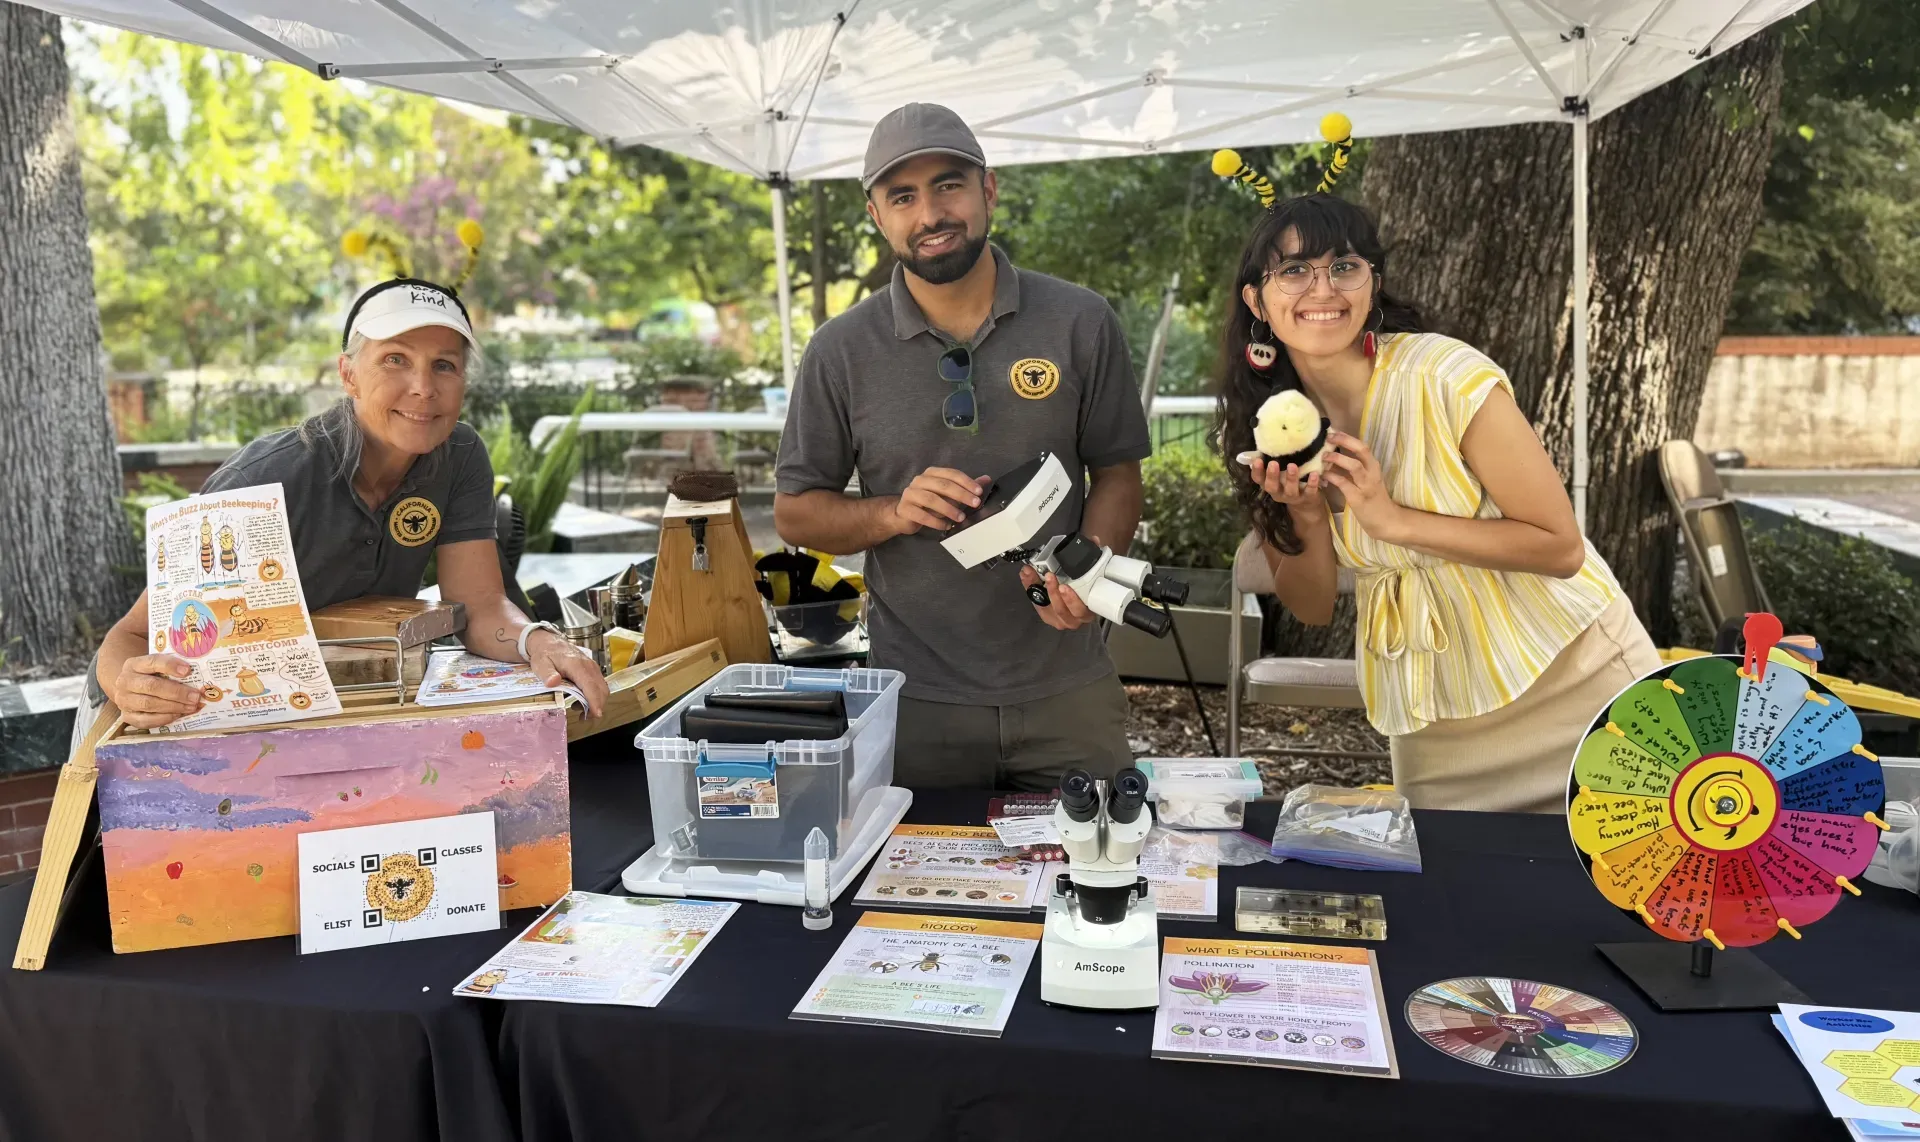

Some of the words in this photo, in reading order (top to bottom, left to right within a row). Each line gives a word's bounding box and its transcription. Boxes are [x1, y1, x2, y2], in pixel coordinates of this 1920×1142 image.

[1017, 360, 1050, 370] CALIFORNIA
[1038, 484, 1059, 513] AmScope
[150, 514, 169, 532] What's
[168, 512, 178, 520] the
[200, 500, 220, 511] About
[222, 498, 278, 511] Beekeeping?
[397, 502, 432, 516] CALIFORNIA
[174, 589, 204, 602] NECTAR
[228, 638, 298, 655] HONEYCOMB
[231, 694, 284, 708] HONEY!
[1758, 697, 1768, 716] and
[1634, 697, 1660, 723] eat?
[1741, 709, 1748, 717] is
[1631, 722, 1643, 735] do
[1793, 728, 1803, 737] is
[1804, 711, 1821, 724] the
[1794, 743, 1804, 754] of
[1817, 706, 1848, 733] worker
[1664, 728, 1691, 756] bees
[1738, 723, 1748, 750] What
[1645, 737, 1679, 764] What
[1621, 779, 1635, 790] do
[1642, 777, 1666, 793] Why
[1647, 770, 1670, 785] have
[1578, 803, 1608, 816] have?
[1613, 800, 1637, 809] bee
[1611, 811, 1638, 822] does
[1637, 815, 1659, 830] How
[1790, 813, 1816, 822] How
[1599, 826, 1633, 839] many
[1780, 823, 1810, 836] eyes
[1814, 828, 1841, 840] does
[441, 845, 482, 857] CLASSES
[1663, 845, 1683, 862] Can
[1821, 840, 1857, 860] have?
[312, 861, 356, 873] SOCIALS
[1650, 861, 1662, 881] you
[1793, 859, 1809, 872] are
[1810, 871, 1834, 894] bees
[1629, 885, 1644, 905] act
[1699, 890, 1708, 907] are
[446, 903, 486, 916] DONATE
[324, 920, 352, 930] ELIST
[1677, 907, 1691, 931] eat
[920, 923, 978, 932] BIOLOGY
[1186, 946, 1222, 955] WHAT
[1246, 949, 1343, 960] POLLINATION?
[1074, 962, 1125, 975] AmScope
[1184, 961, 1255, 969] POLLINATION
